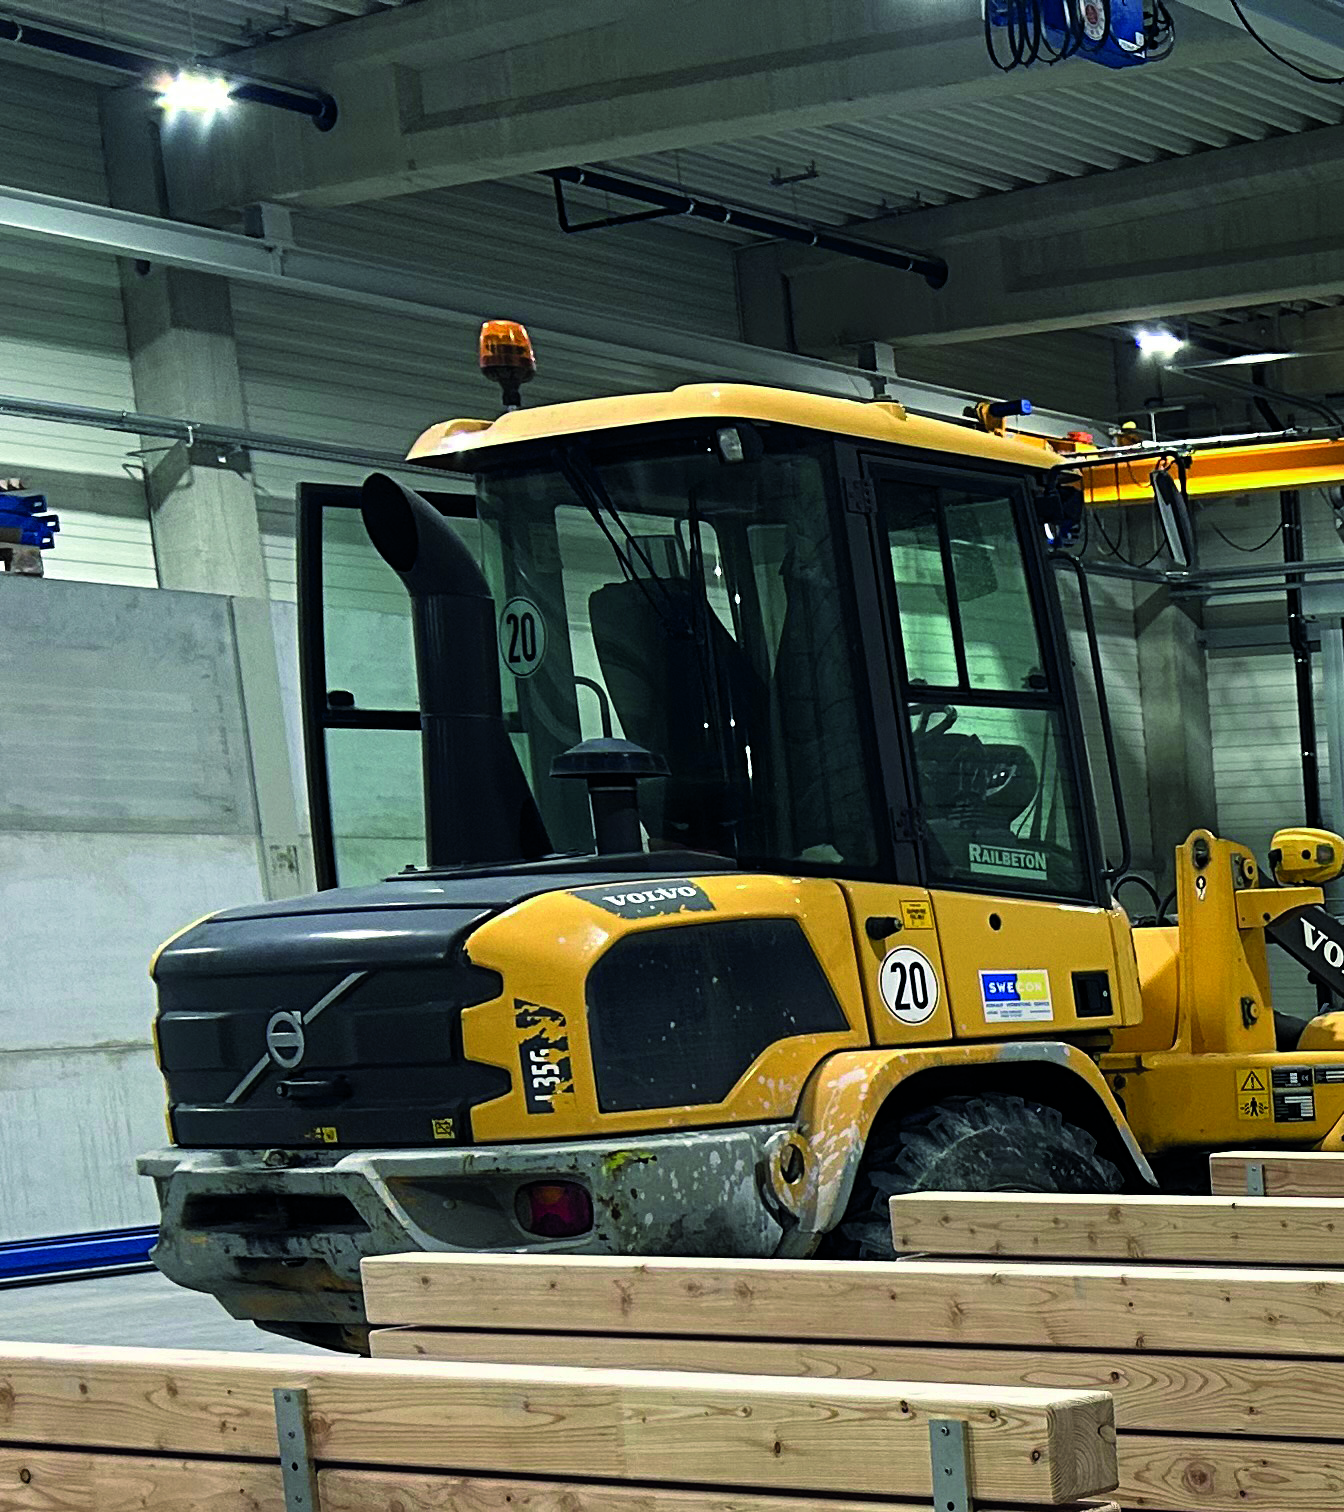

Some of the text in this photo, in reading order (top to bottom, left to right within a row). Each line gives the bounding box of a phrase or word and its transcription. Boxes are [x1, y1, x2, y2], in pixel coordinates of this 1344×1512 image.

[507, 612, 537, 663] 20
[969, 843, 1046, 870] RAILBETON
[602, 886, 697, 906] VOLVO
[890, 961, 929, 1010] 20
[988, 981, 1043, 994] SWECON
